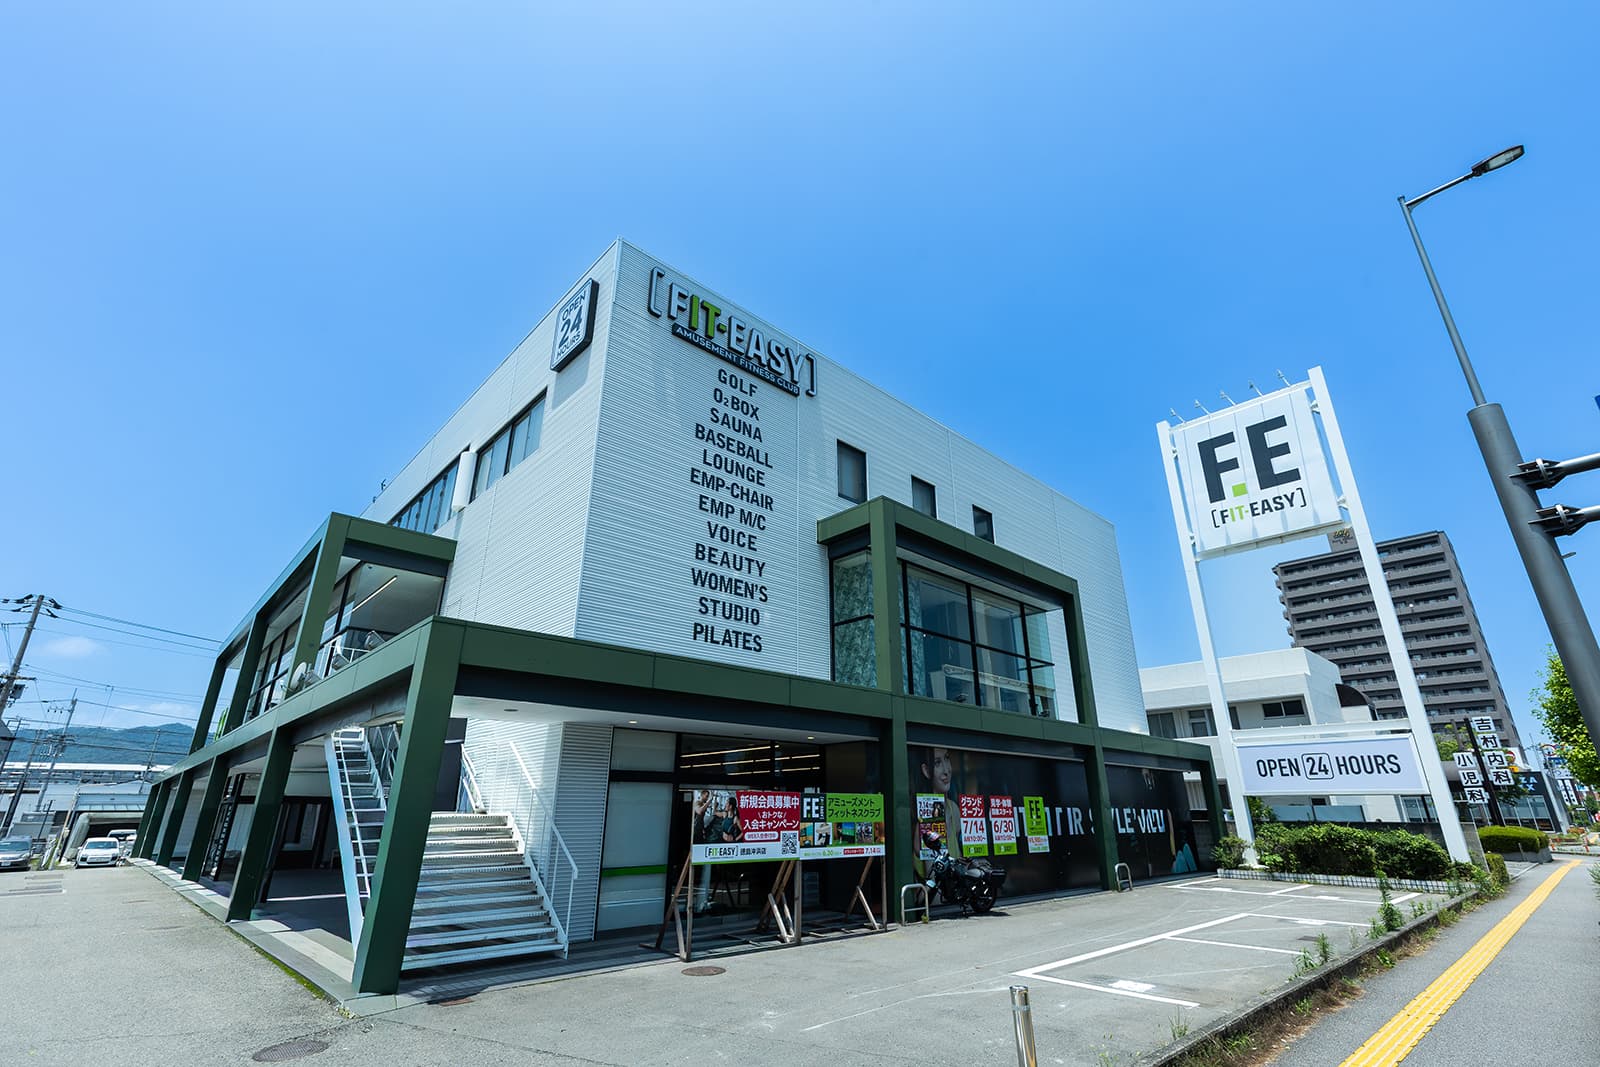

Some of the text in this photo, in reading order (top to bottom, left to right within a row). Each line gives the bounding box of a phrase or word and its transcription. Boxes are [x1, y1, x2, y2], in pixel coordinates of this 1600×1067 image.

[562, 290, 587, 321] OPEN
[559, 304, 583, 349] 24
[556, 331, 581, 360] HOURS
[675, 326, 800, 395] AMUSEMENT FITNESS CLUB
[718, 368, 758, 397] GOLF
[710, 407, 763, 443] SAUNA
[695, 423, 773, 469] BASEBALL
[703, 449, 766, 487] LOUNGE
[690, 467, 774, 511] EMP-CHAIR
[699, 494, 766, 531] EMP M/C
[707, 521, 758, 552] VOICE
[695, 542, 766, 577] BEAUTY
[691, 567, 768, 603] WOMEN'S
[698, 597, 760, 626] STUDIO
[693, 622, 762, 652] PILATES
[1256, 754, 1401, 778] OPEN 24 HOURS
[1475, 718, 1511, 784] 吉村内科
[1457, 753, 1485, 802] 小児科
[740, 795, 799, 810] 新規会員募集中
[827, 797, 875, 807] アミューズメント
[827, 808, 881, 818] フィットネスクラブ
[961, 797, 982, 807] グランド
[962, 807, 983, 817] オープン
[743, 819, 799, 830] 入会キャンペーン
[962, 820, 985, 834] 7/14
[993, 820, 1014, 833] 6/30
